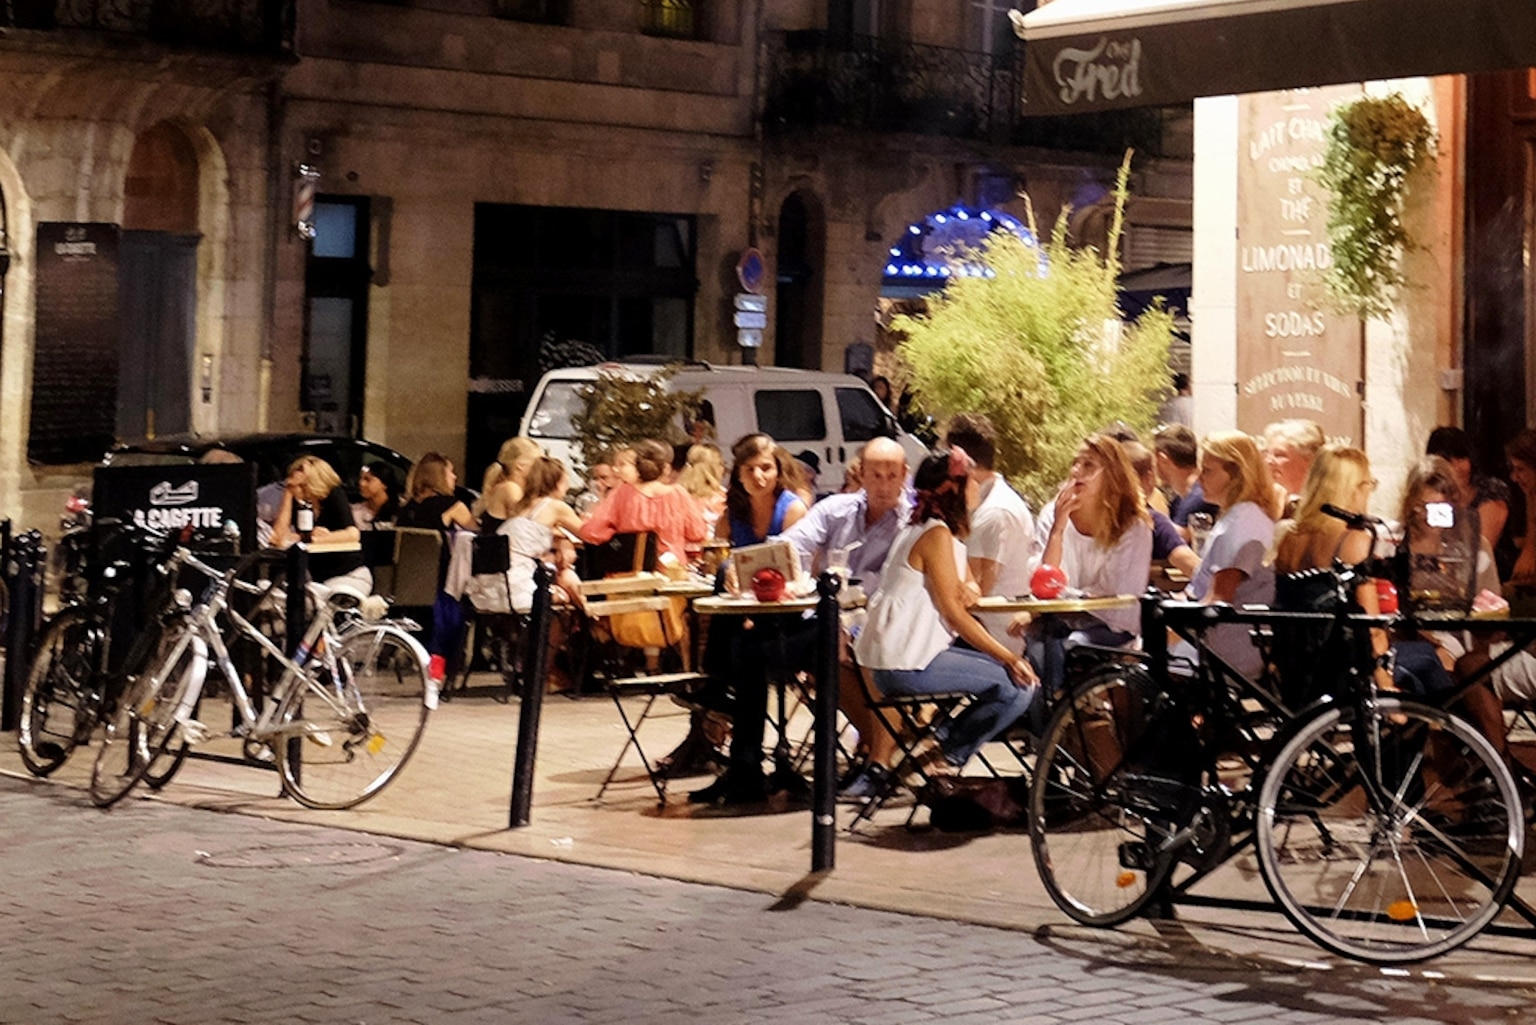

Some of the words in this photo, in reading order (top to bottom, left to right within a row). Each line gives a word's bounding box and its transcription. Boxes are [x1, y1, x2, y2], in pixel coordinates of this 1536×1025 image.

[1053, 36, 1143, 105] Fred
[1250, 119, 1286, 160] LAIT
[1242, 242, 1331, 273] LIMONAD
[1287, 282, 1303, 299] ET
[1265, 310, 1326, 337] SODAS
